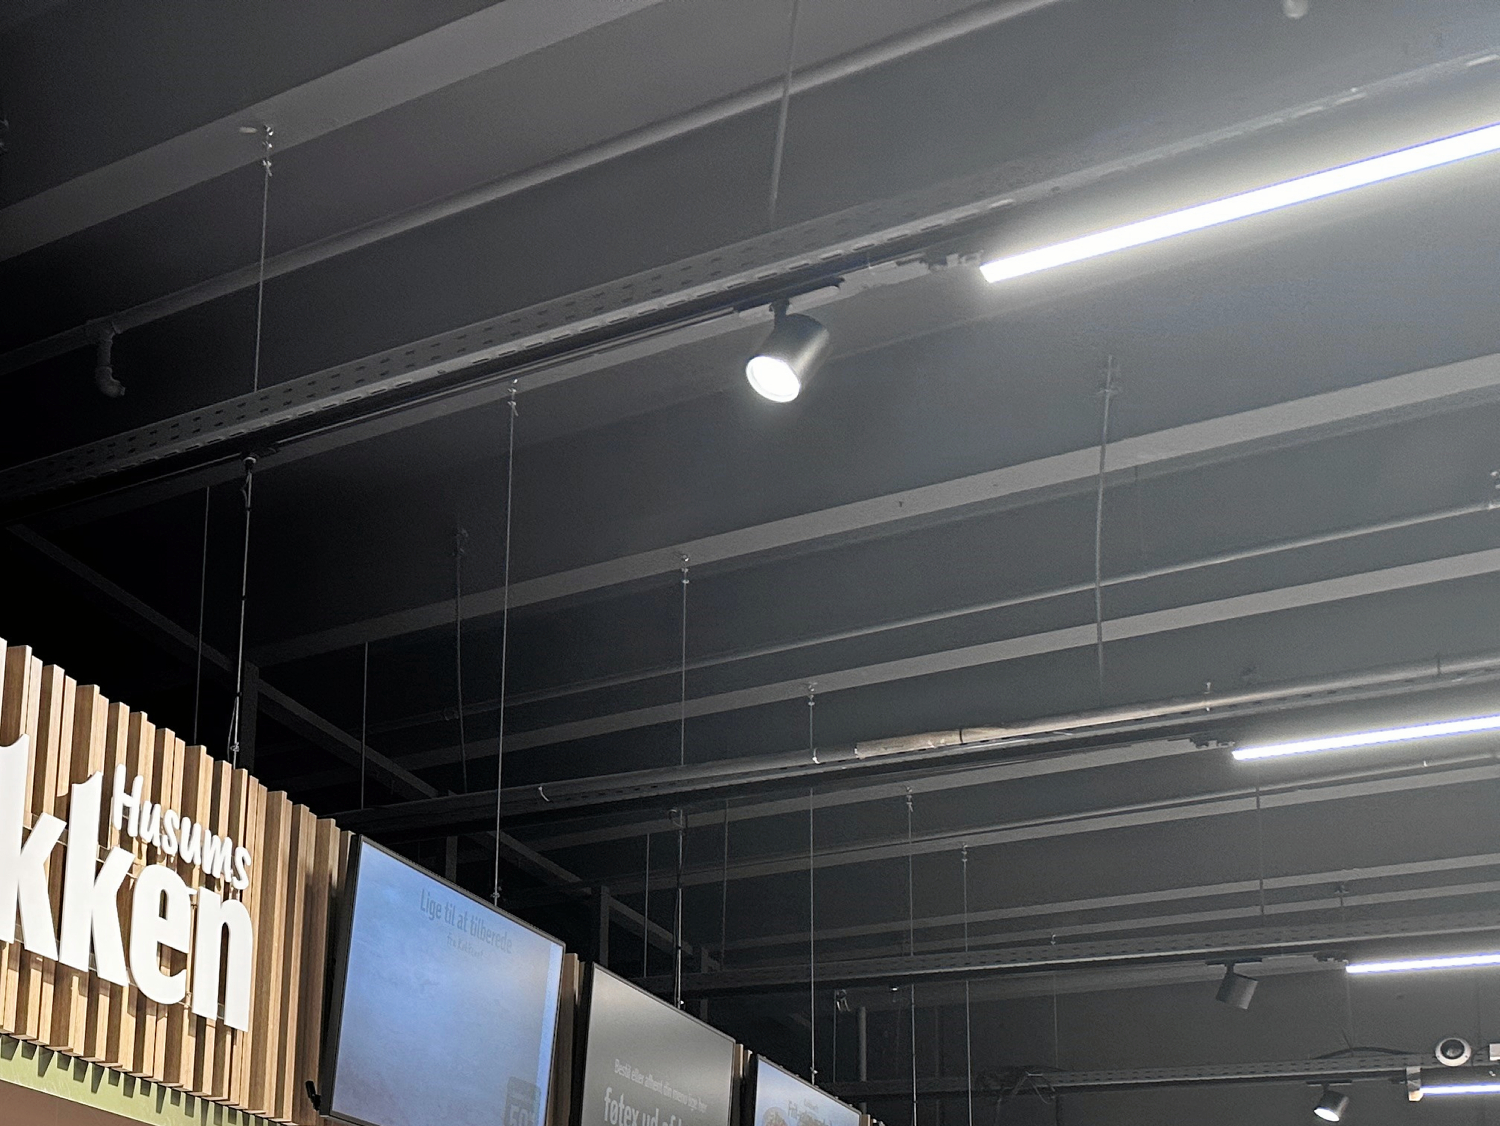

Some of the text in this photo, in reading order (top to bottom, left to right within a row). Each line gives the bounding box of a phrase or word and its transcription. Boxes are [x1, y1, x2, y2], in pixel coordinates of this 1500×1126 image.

[111, 763, 252, 891] Husums
[420, 889, 442, 921] Lige
[444, 900, 456, 927] til
[457, 911, 468, 932] at
